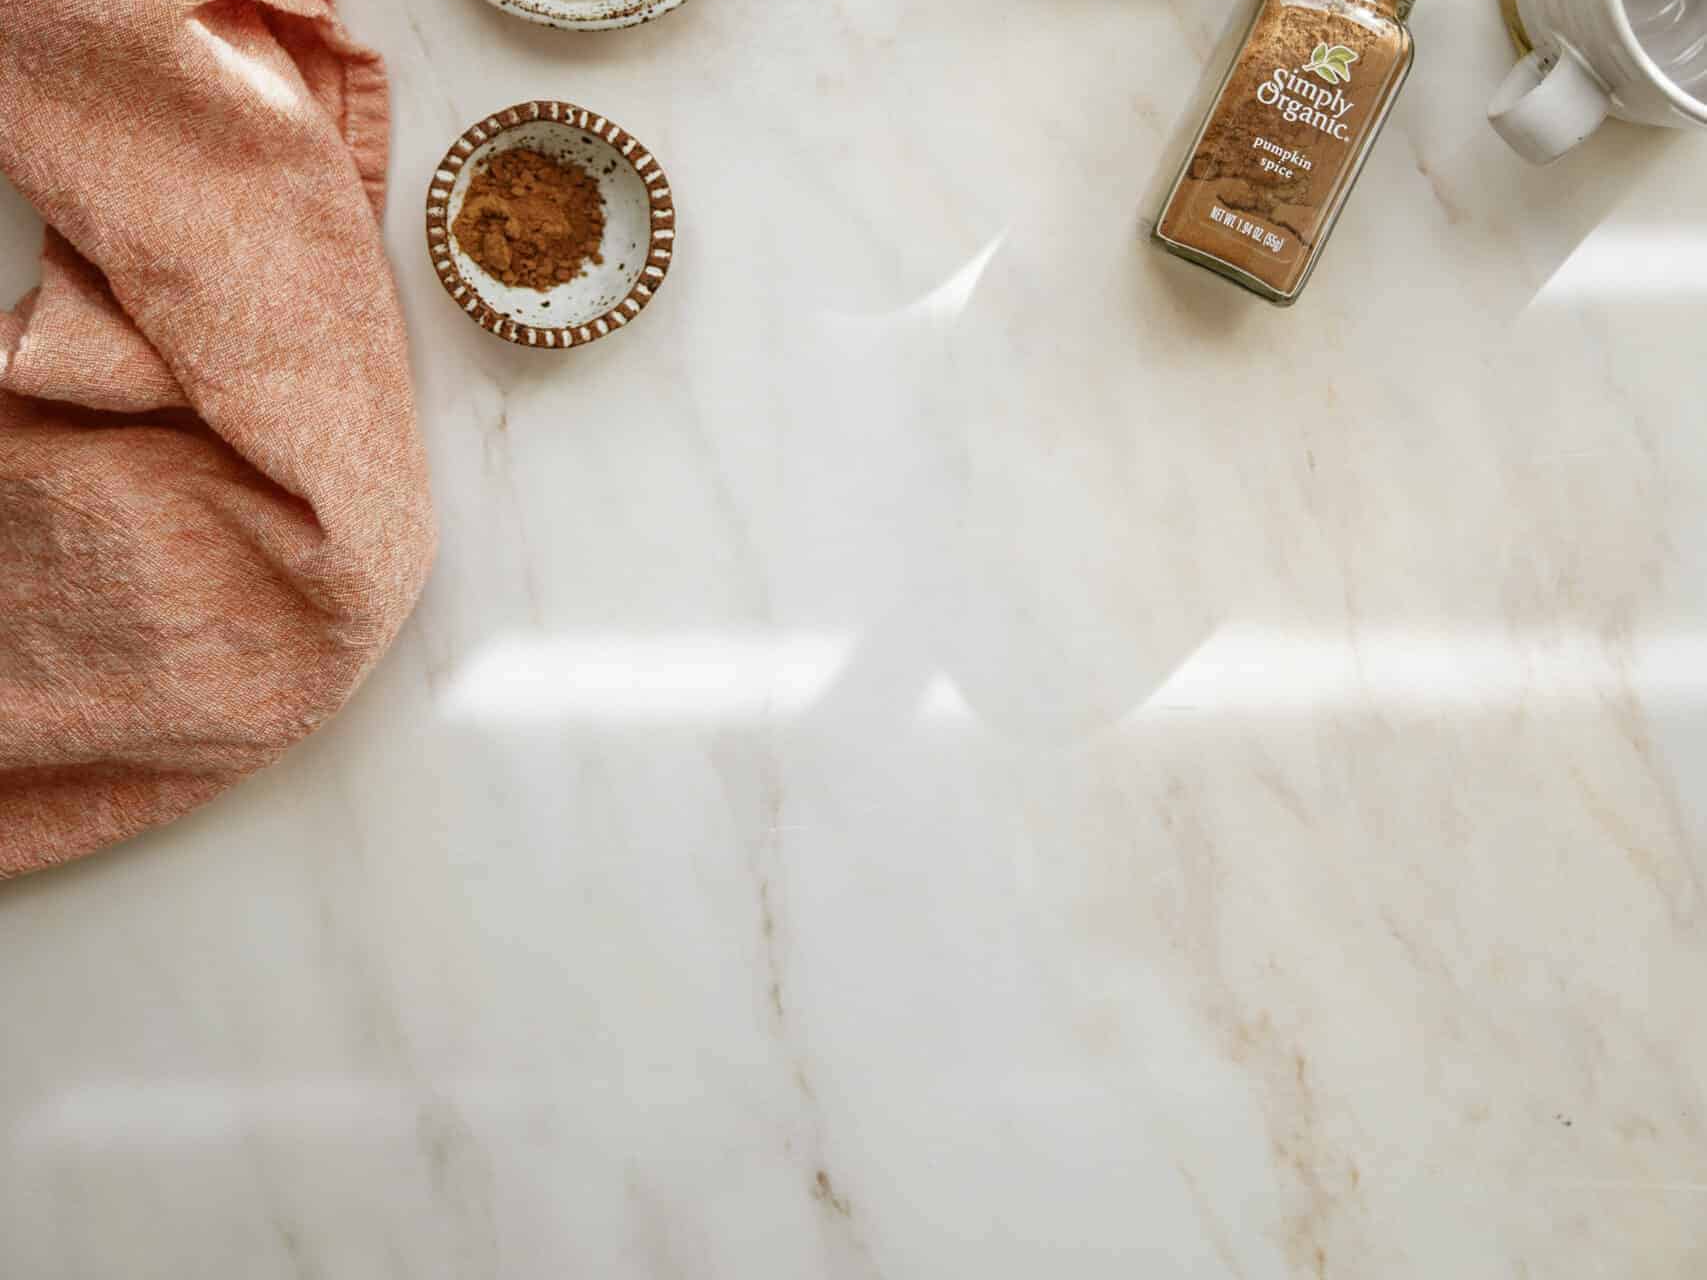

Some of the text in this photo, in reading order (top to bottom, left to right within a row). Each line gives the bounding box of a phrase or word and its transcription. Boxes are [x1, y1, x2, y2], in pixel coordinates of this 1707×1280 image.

[1267, 68, 1354, 118] Simply
[1252, 136, 1313, 170] pumpkin
[1260, 157, 1294, 178] spice
[1210, 205, 1226, 222] NET
[1262, 231, 1284, 253] (55g)
